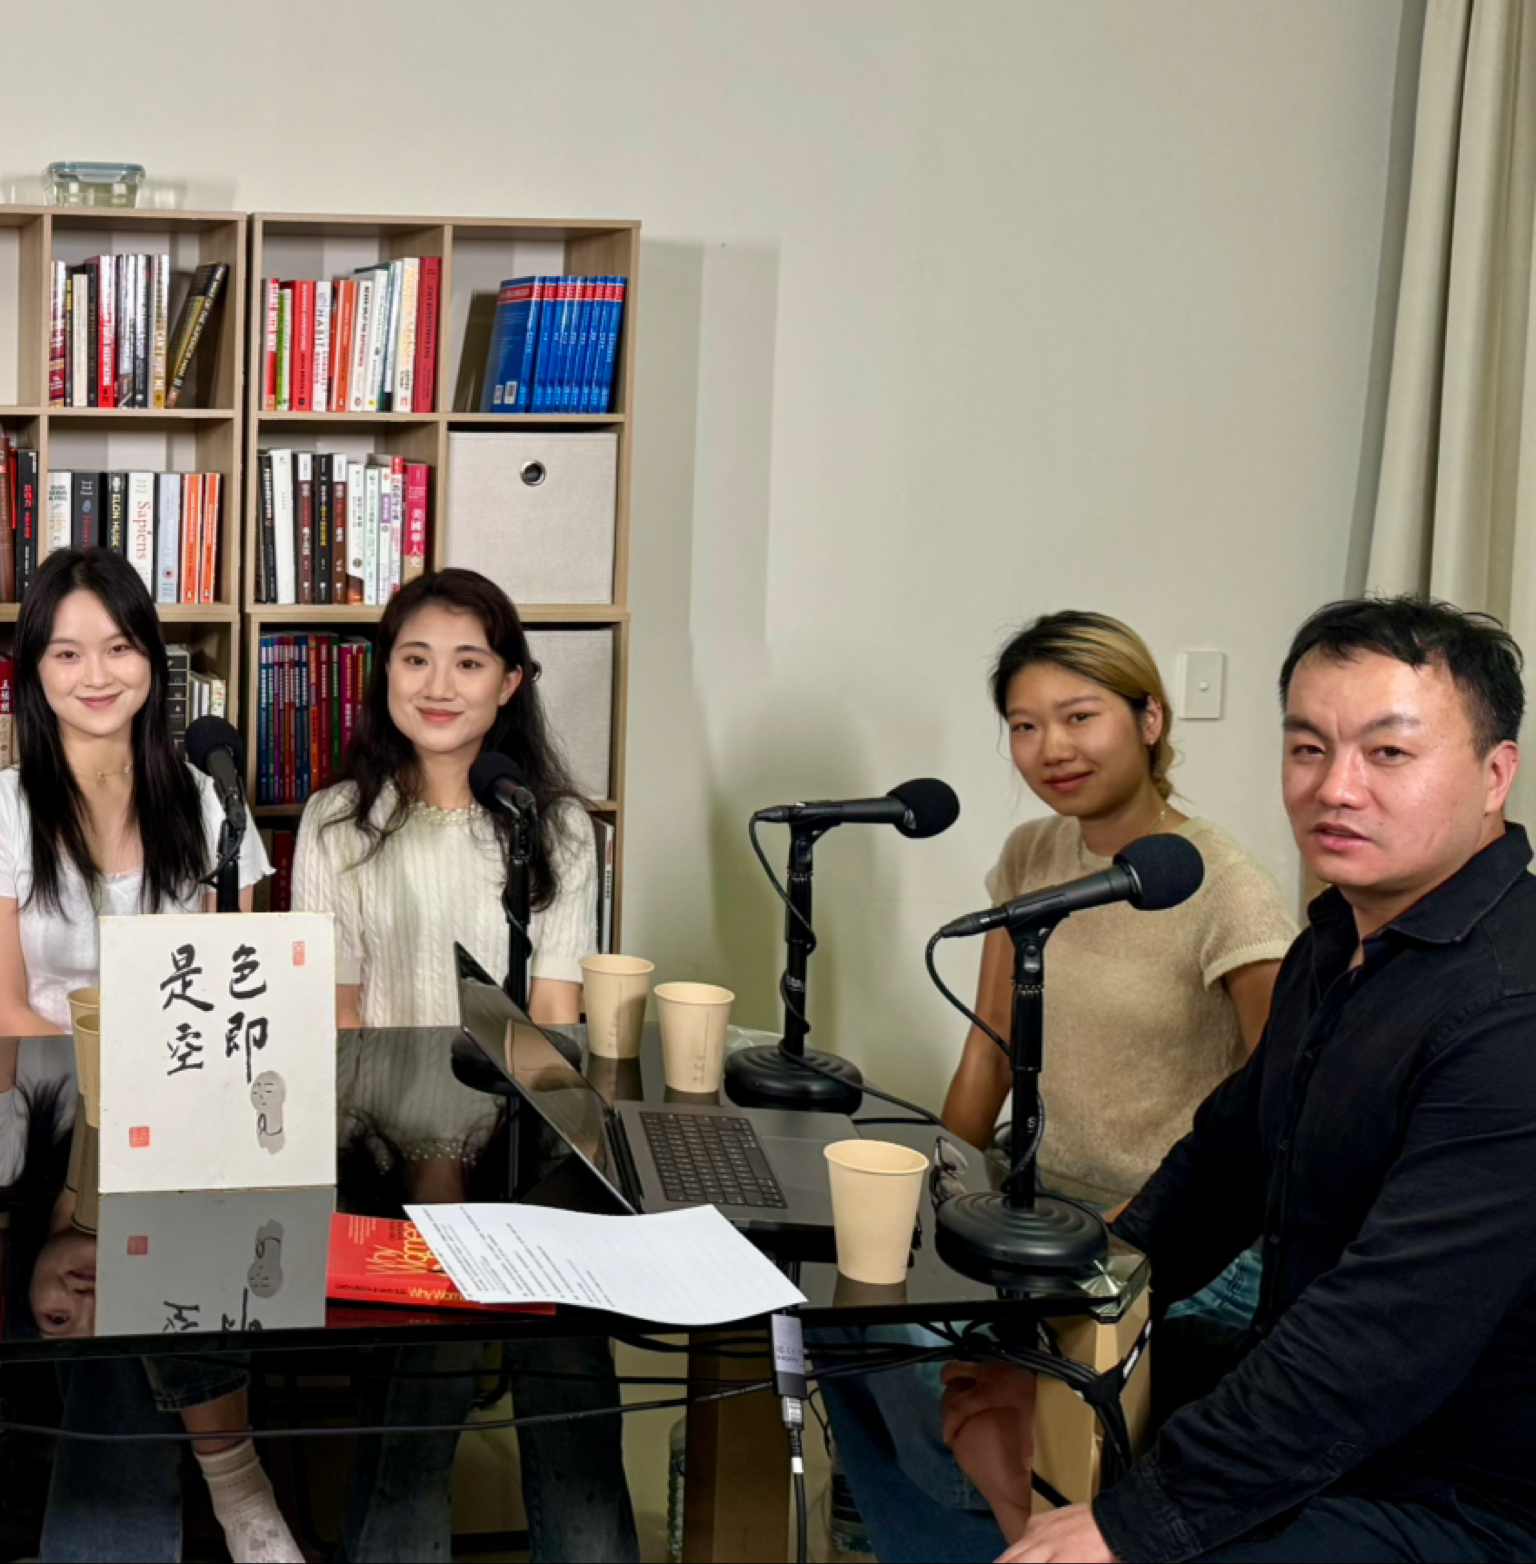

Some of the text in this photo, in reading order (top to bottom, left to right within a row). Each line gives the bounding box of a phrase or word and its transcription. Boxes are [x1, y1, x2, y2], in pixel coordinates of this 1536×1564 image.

[132, 501, 153, 561] Sapiens
[159, 943, 214, 1076] 是空
[225, 943, 269, 1085] 色即
[365, 1244, 404, 1276] Why
[431, 1289, 461, 1301] Wom
